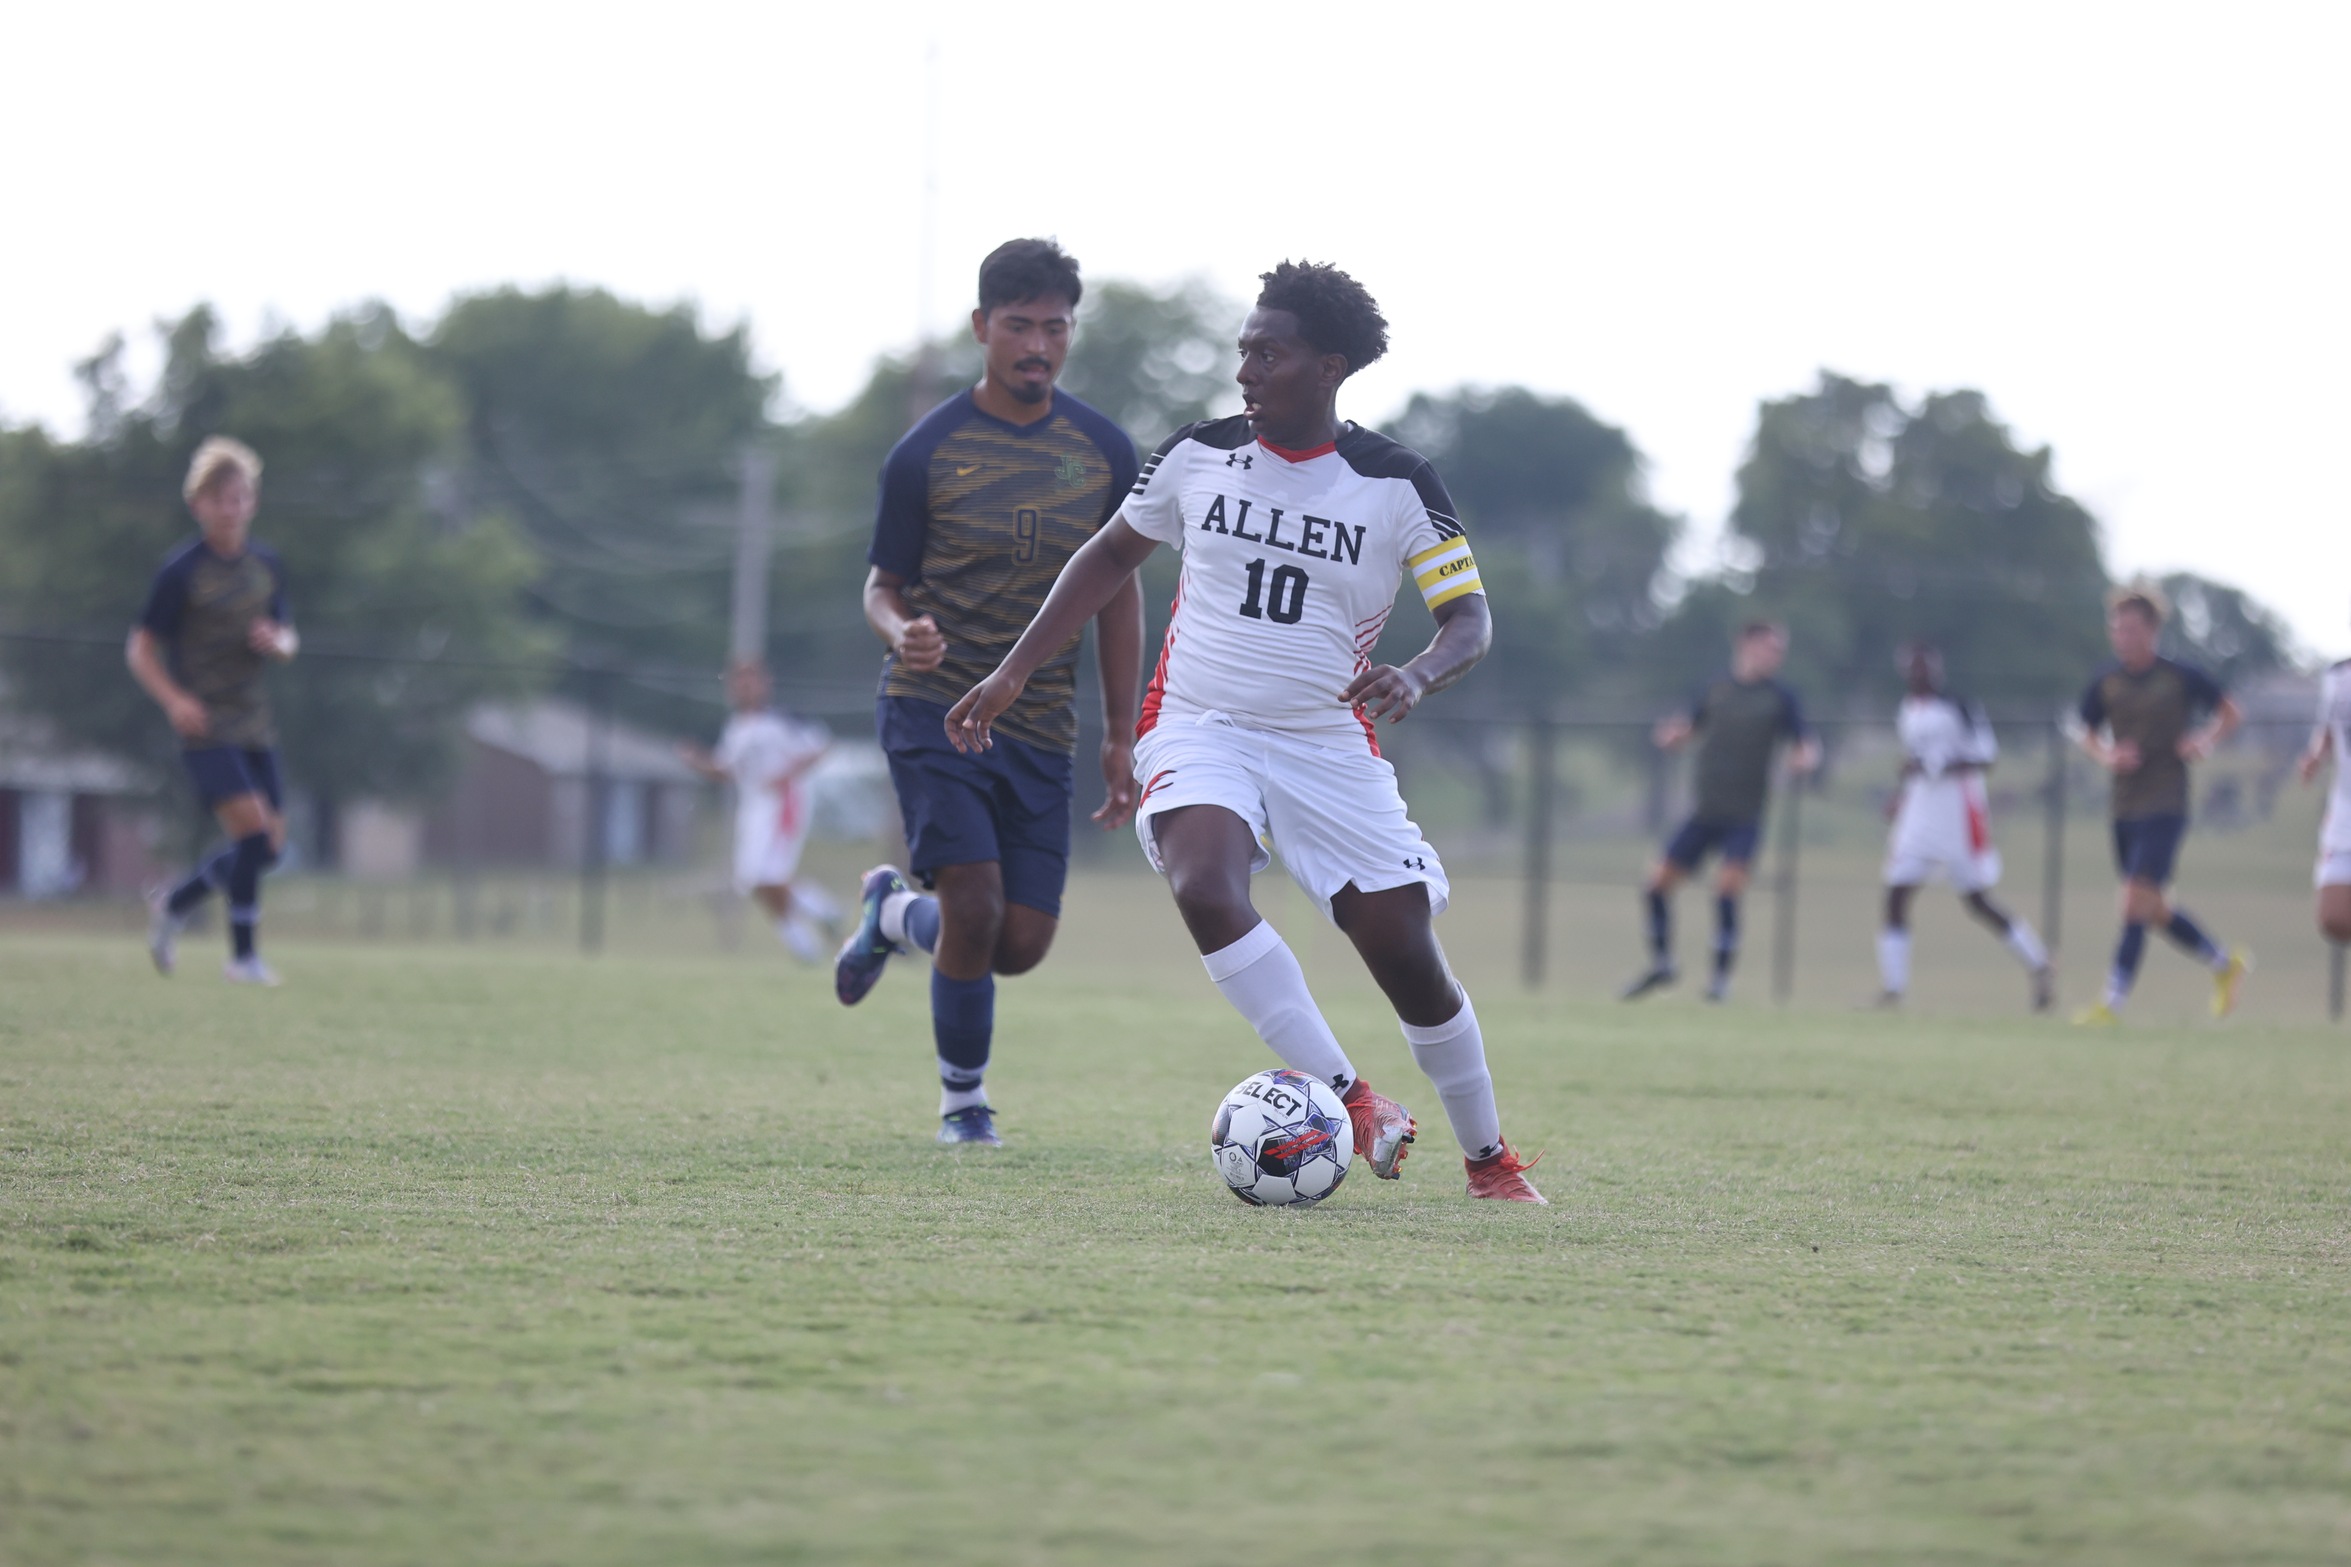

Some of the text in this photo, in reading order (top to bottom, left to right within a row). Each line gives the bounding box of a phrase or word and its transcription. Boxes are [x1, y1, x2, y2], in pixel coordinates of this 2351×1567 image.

[1011, 504, 1042, 567] 9
[1201, 494, 1366, 565] ALLEN
[1239, 557, 1309, 625] 10
[1234, 1081, 1302, 1117] SELECT
